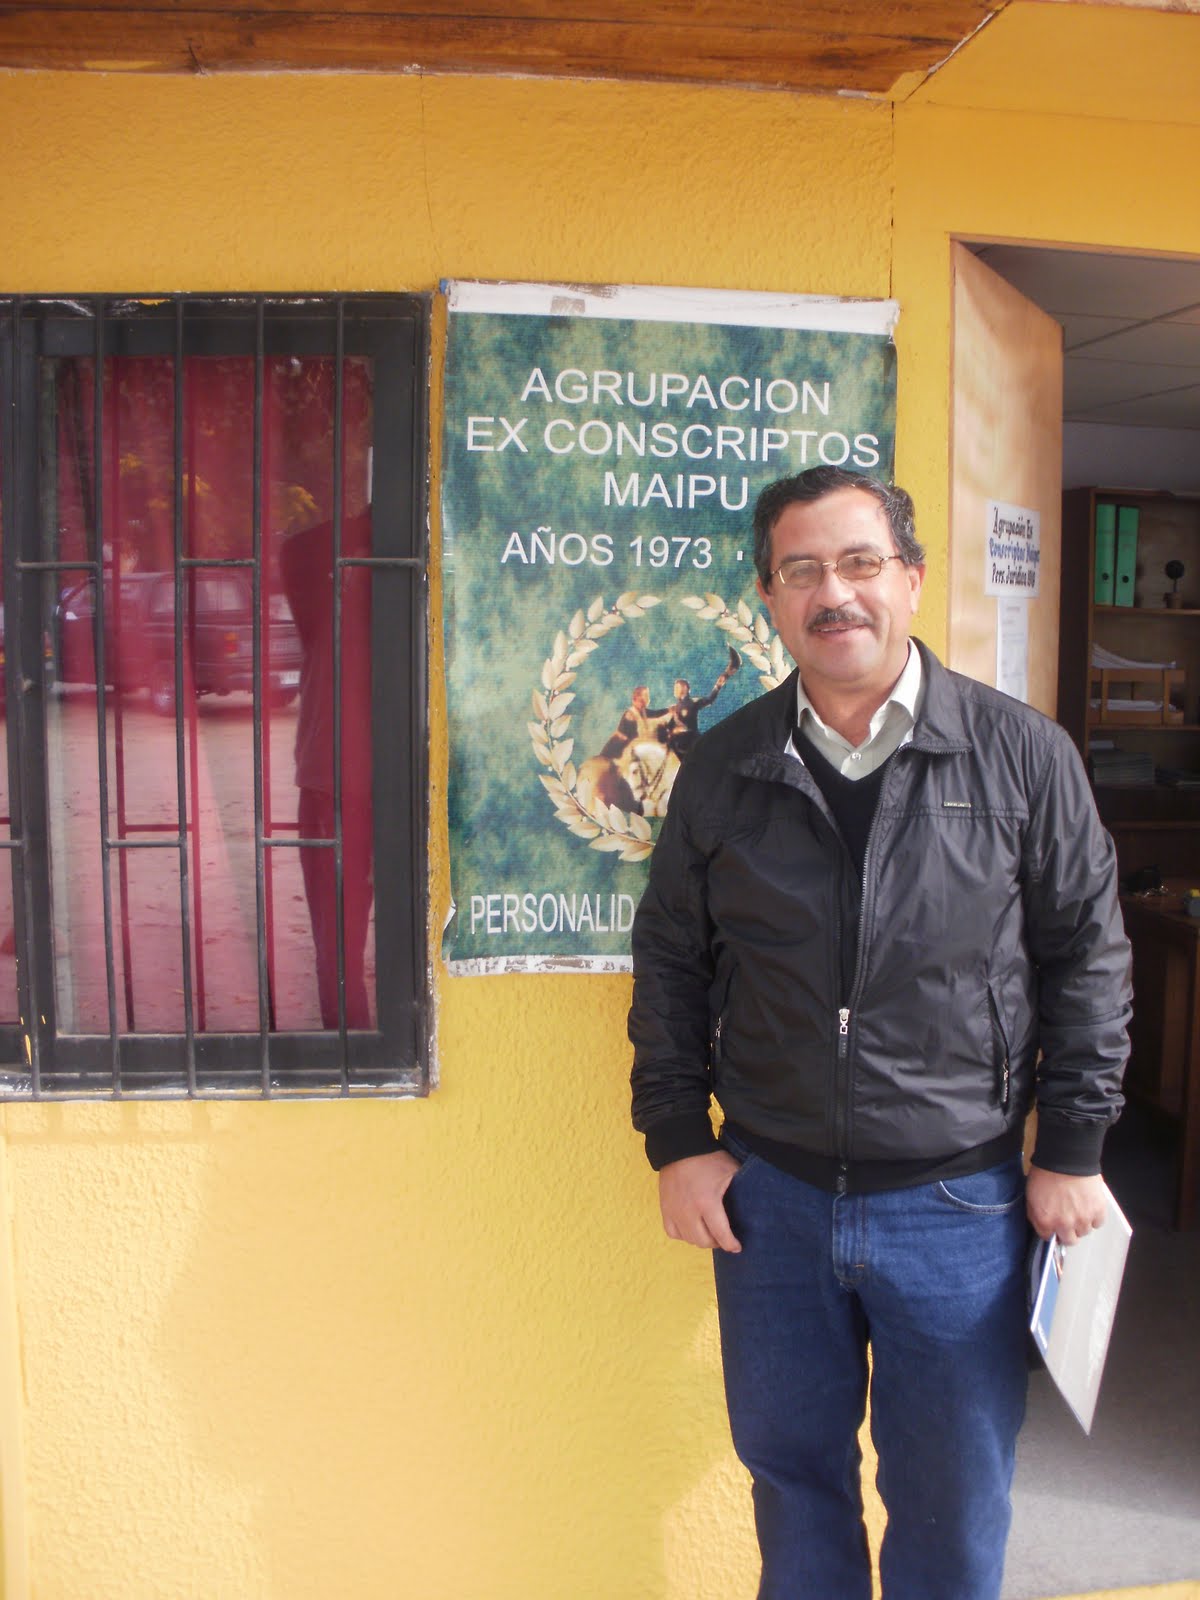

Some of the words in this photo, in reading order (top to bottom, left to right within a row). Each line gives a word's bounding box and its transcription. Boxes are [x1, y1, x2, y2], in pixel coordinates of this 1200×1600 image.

[520, 367, 830, 415] AGRUPACION
[466, 416, 528, 453] EX
[543, 418, 880, 468] CONSCRIPTOS
[603, 471, 749, 511] MAIPU
[501, 526, 614, 566] AÑOS
[629, 535, 712, 569] 1973
[470, 893, 635, 935] PERSONALID
